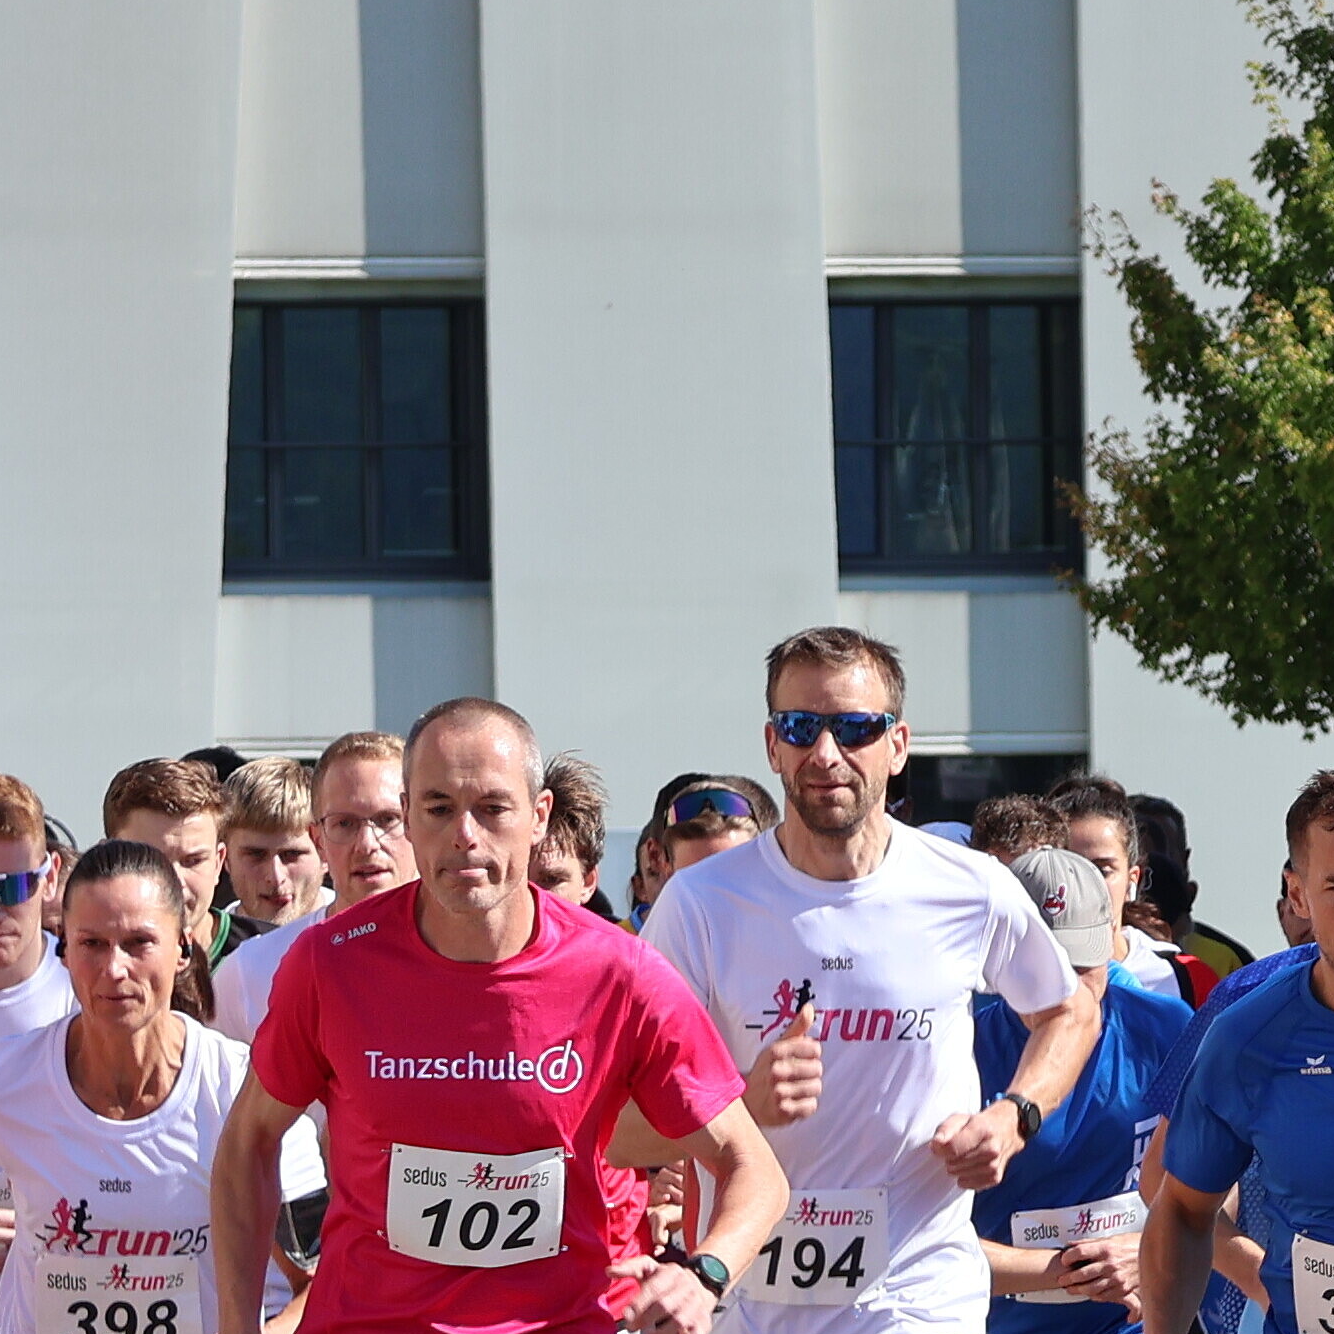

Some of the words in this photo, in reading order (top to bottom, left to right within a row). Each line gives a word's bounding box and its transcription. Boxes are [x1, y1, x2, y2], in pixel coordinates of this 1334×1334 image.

[348, 922, 377, 939] JAKO
[821, 956, 853, 970] sedus
[364, 1051, 535, 1080] Tanzschule
[99, 1177, 132, 1193] sedus
[403, 1166, 447, 1187] sedus
[421, 1198, 541, 1251] 102
[1024, 1223, 1059, 1242] sedus
[759, 1236, 866, 1289] 194
[47, 1272, 87, 1291] sedus
